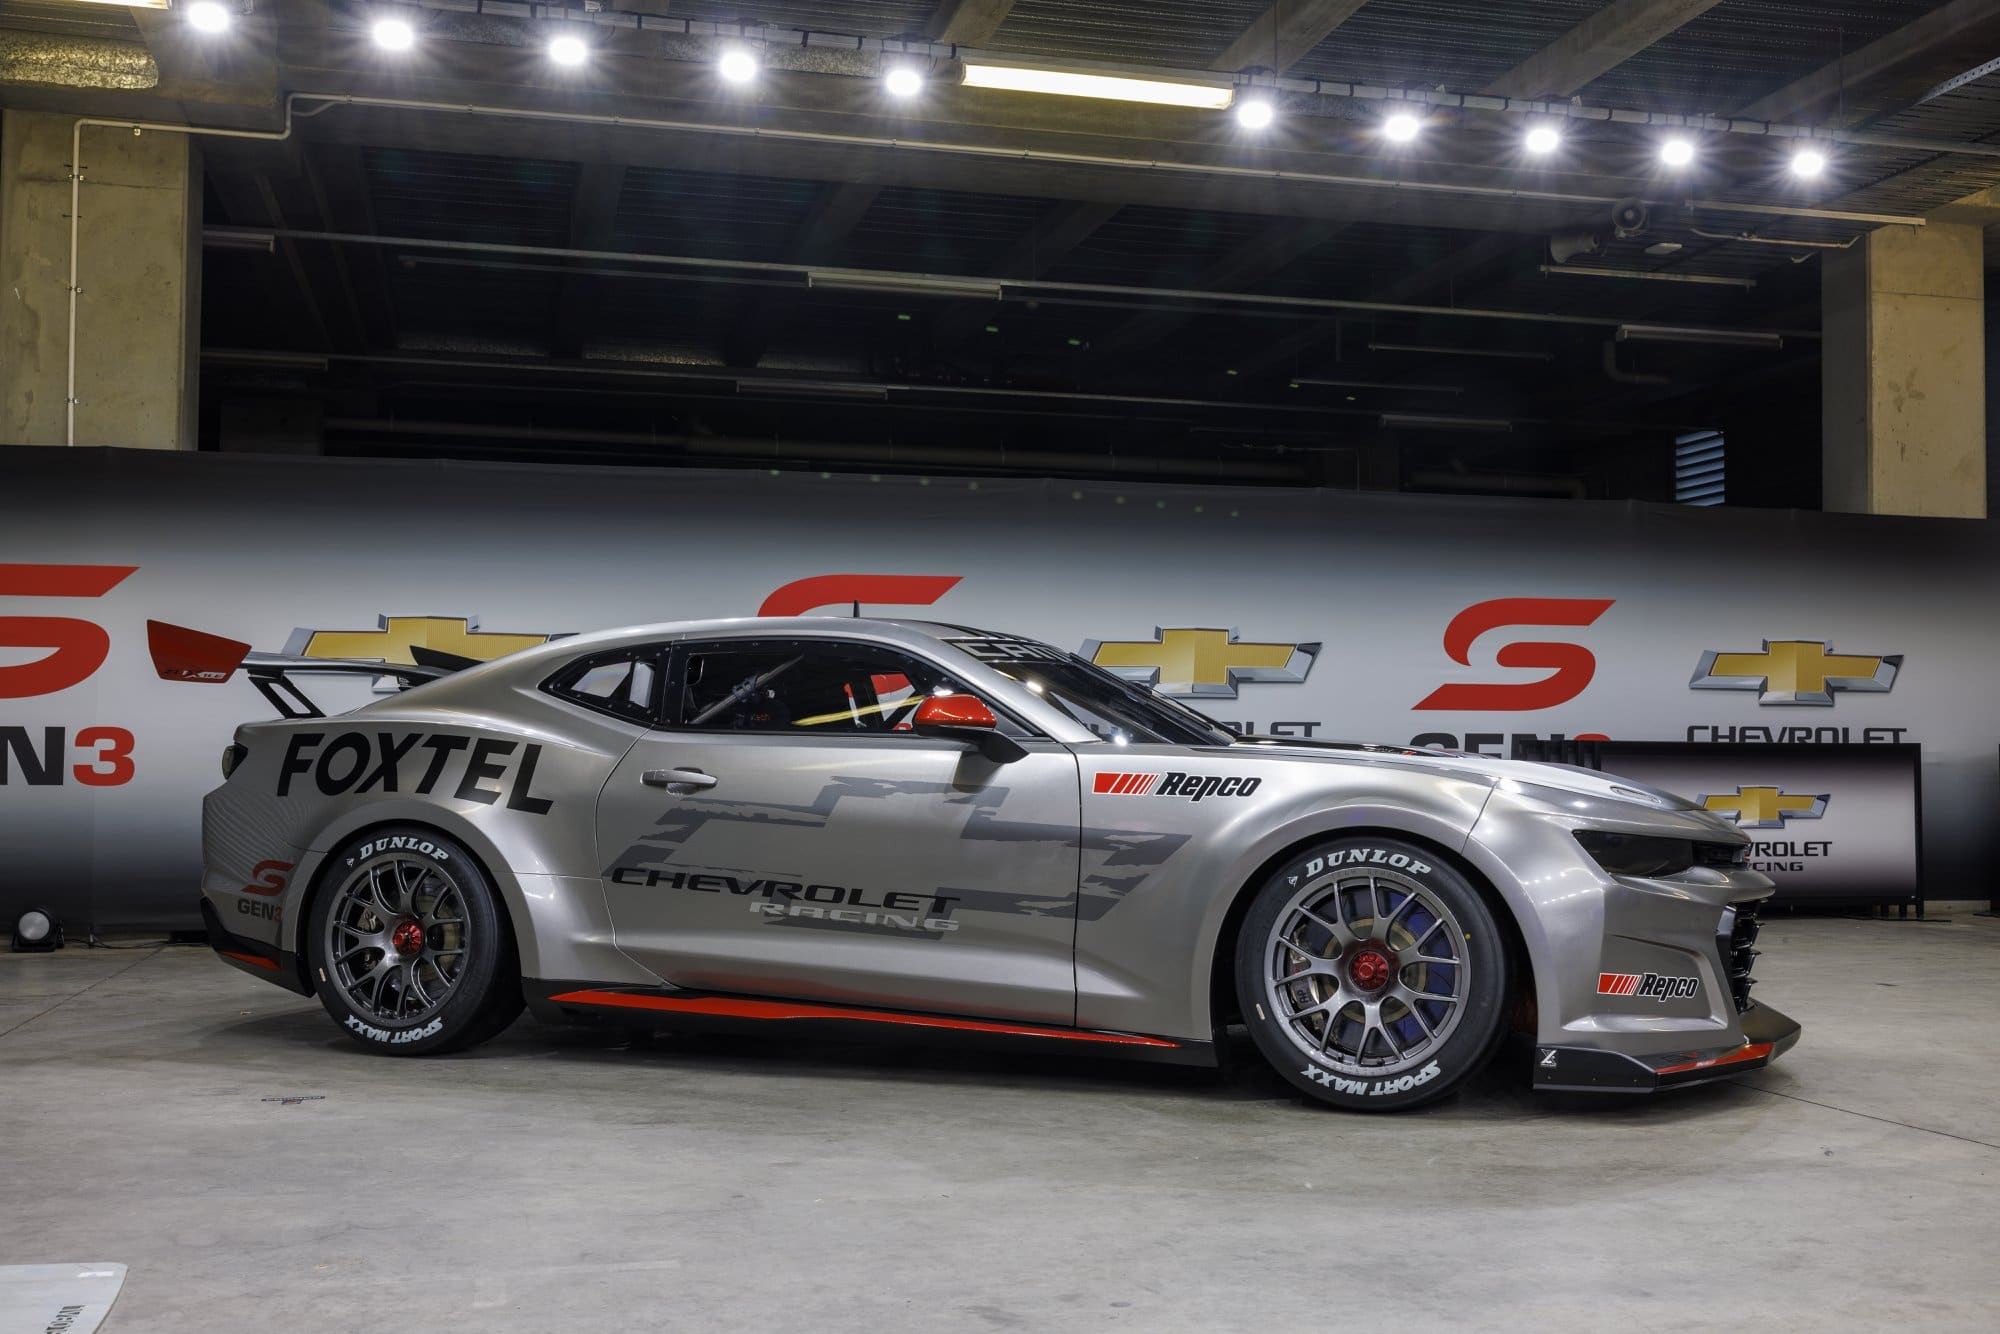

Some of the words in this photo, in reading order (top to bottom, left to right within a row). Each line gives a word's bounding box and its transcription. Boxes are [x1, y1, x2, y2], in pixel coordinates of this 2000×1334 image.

[1411, 598, 1617, 711] S
[1687, 725, 1908, 744] CHEVROLET
[0, 726, 135, 787] N3
[277, 732, 554, 815] FOXTEL
[1155, 771, 1262, 801] Repco
[360, 836, 449, 860] DUNLOP
[1747, 841, 1833, 857] ROLET
[1306, 848, 1432, 878] DUNLOP
[1750, 861, 1804, 872] CING
[611, 867, 960, 914] CHEVROLET
[237, 898, 283, 922] GEN3
[750, 902, 959, 931] RACING
[1638, 973, 1698, 1002] Repco
[344, 1014, 391, 1042] MAXX
[390, 1016, 443, 1044] SPORT
[1300, 1063, 1369, 1096] MAXX
[1369, 1059, 1442, 1096] SPORT
